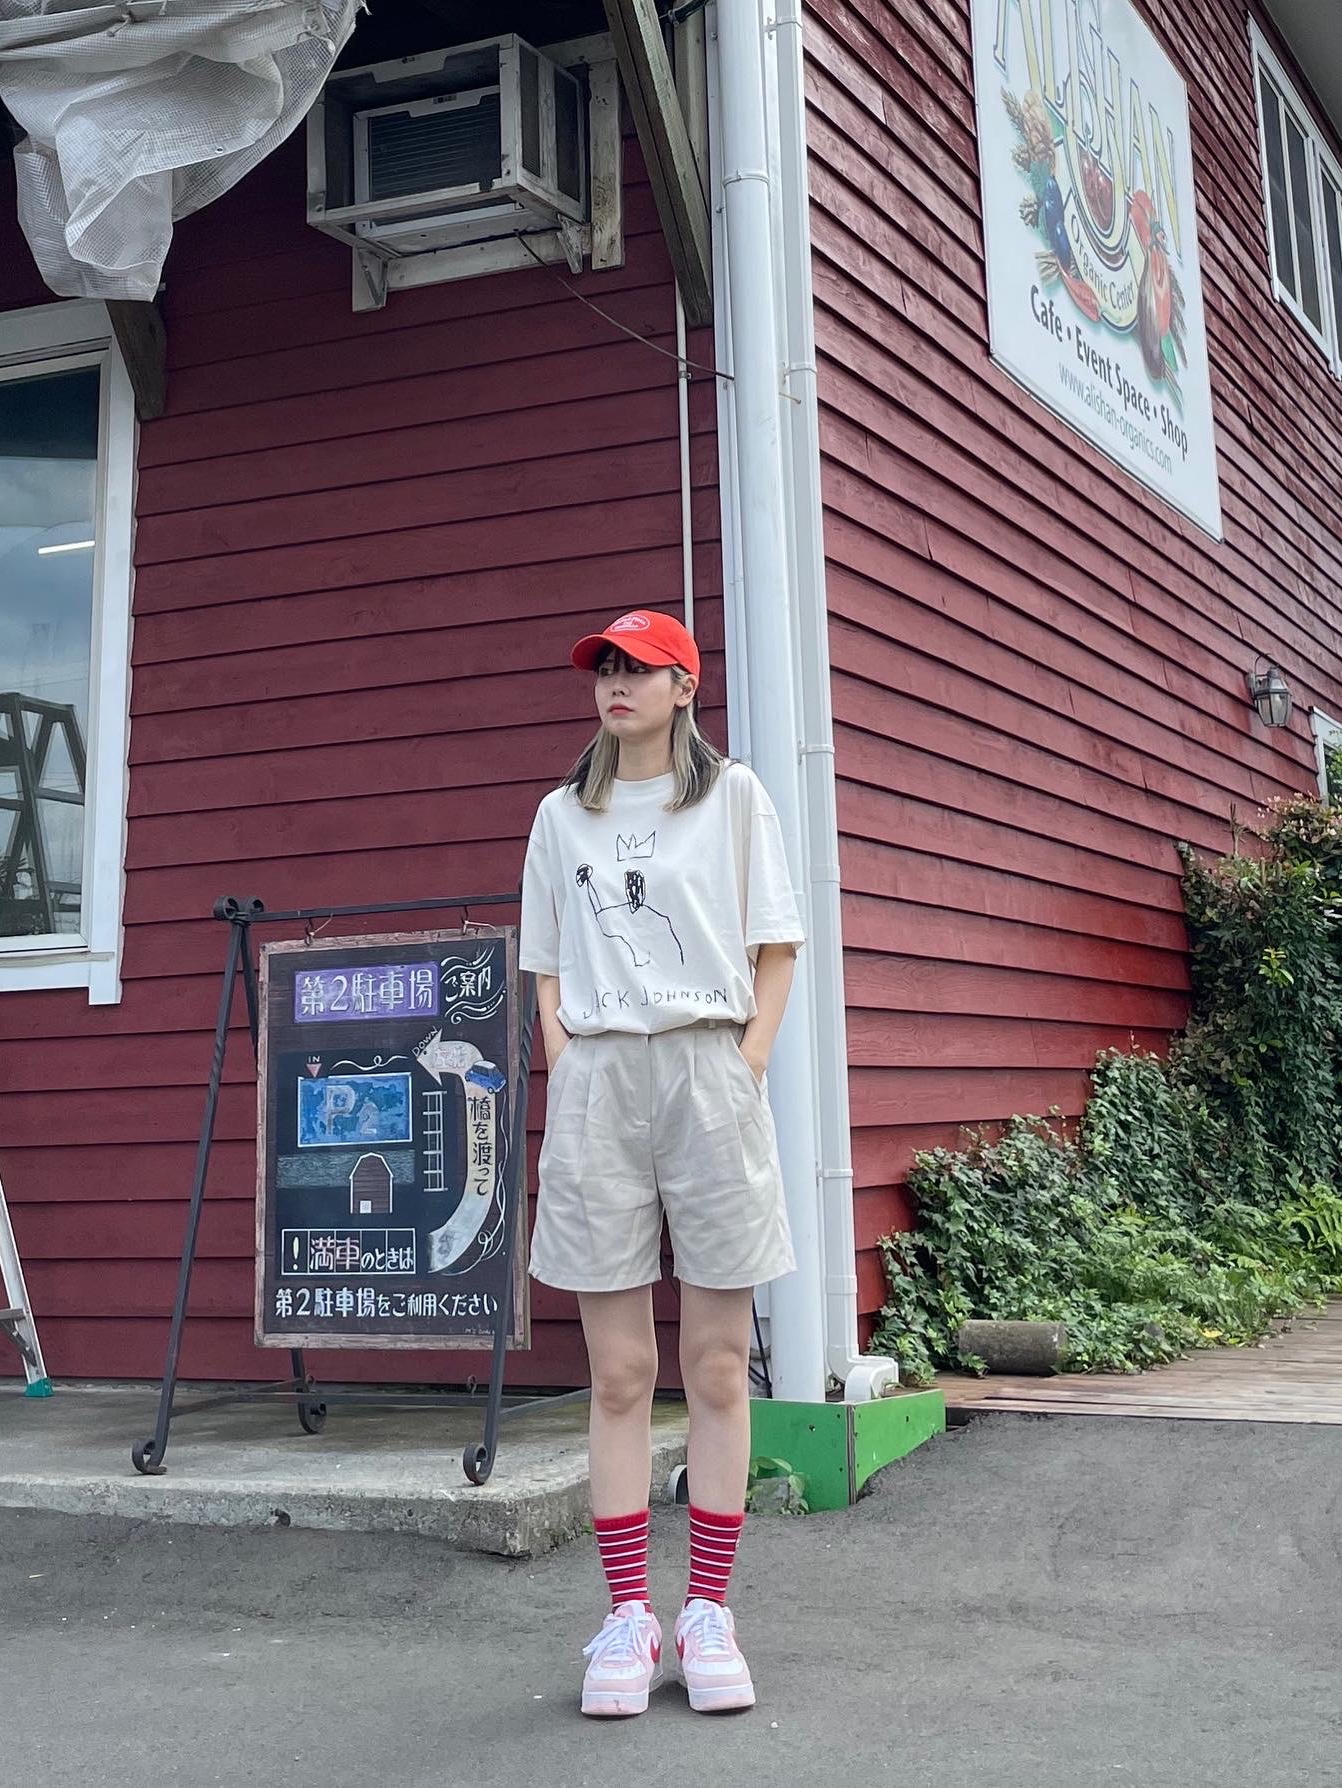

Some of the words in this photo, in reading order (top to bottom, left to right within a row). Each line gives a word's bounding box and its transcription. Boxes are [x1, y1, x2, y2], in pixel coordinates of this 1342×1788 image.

[1071, 214, 1107, 302] Organic
[1109, 281, 1136, 310] Center
[1031, 285, 1063, 343] Cafe
[1075, 324, 1113, 389] Event
[1115, 363, 1151, 421] Space
[1161, 404, 1188, 461] Shop
[1058, 362, 1172, 475] www.alishan-organics.com
[301, 969, 434, 1016] 第2駐車場
[444, 965, 491, 1002] ご案内
[641, 985, 727, 1007] JOHNSON
[308, 1055, 320, 1063] IN
[411, 1025, 438, 1057] DOWN
[468, 1096, 493, 1196] 橋を渡って
[275, 1287, 498, 1318] 第2駐車場をご利用ください
